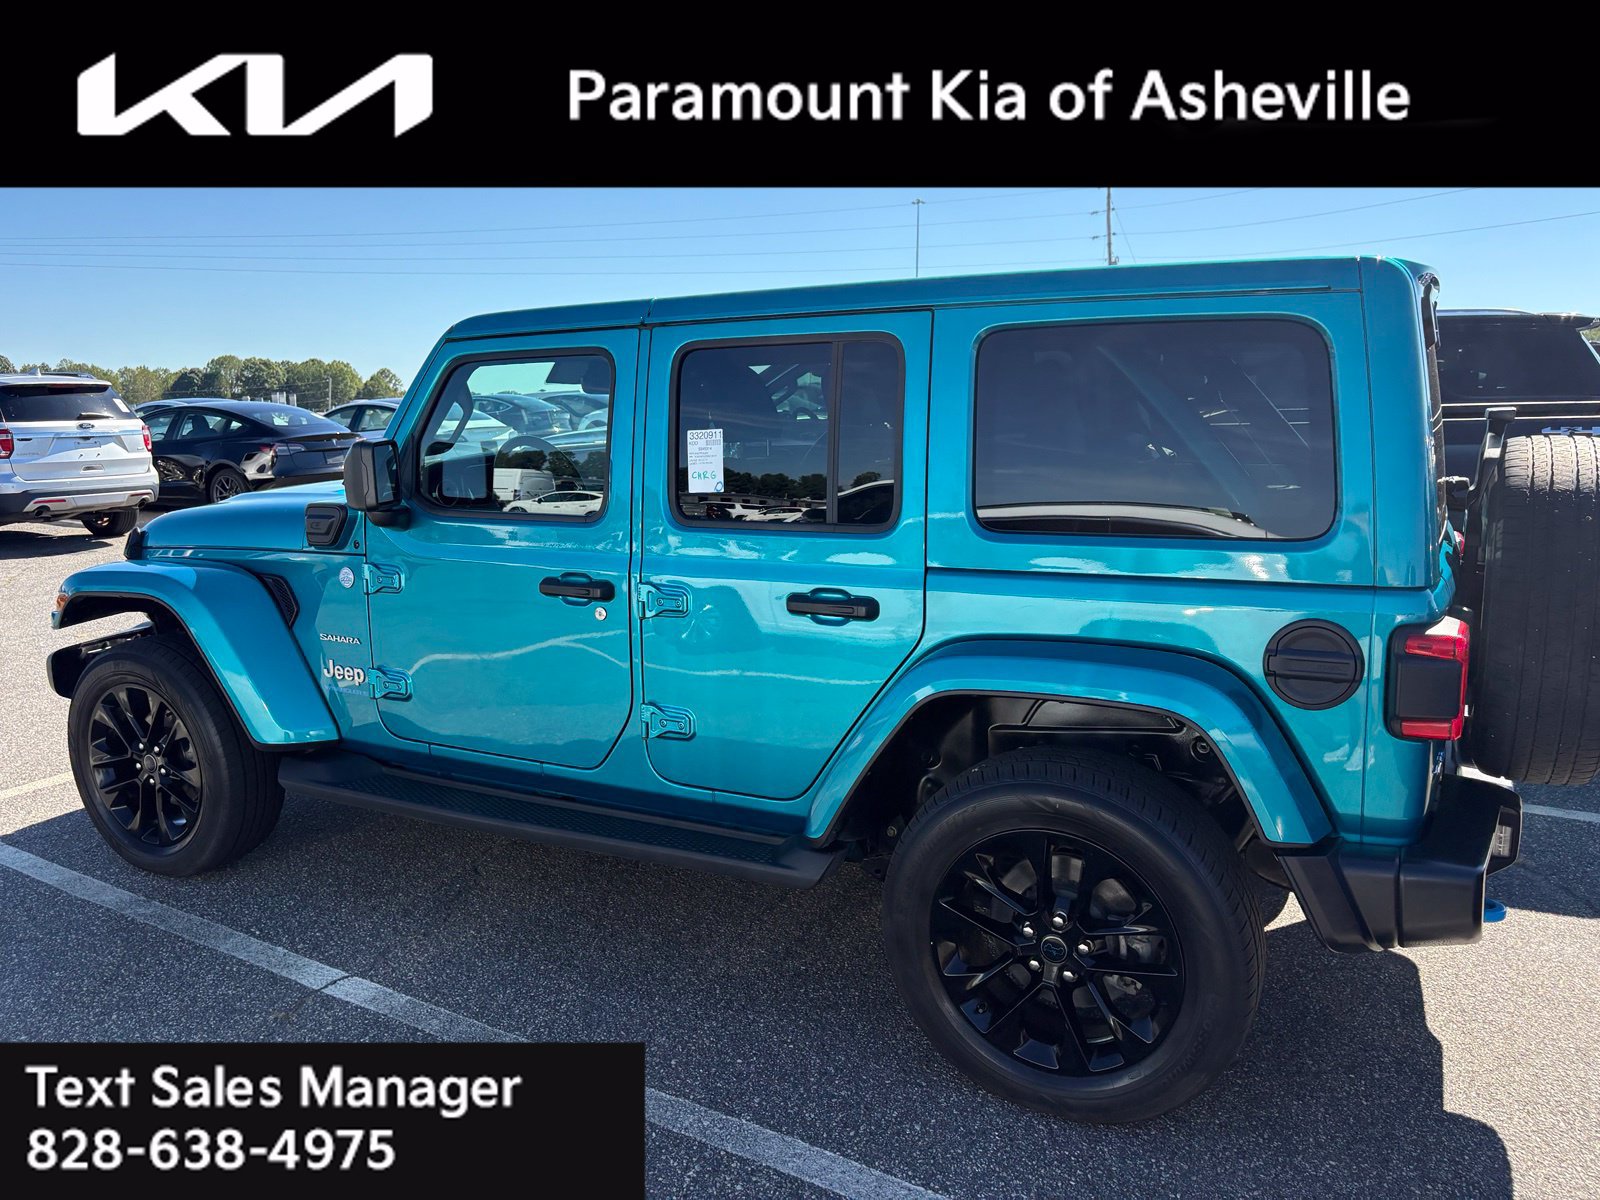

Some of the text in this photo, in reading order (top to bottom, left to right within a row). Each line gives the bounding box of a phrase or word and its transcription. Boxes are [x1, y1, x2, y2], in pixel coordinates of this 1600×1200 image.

[689, 431, 722, 440] 3320911
[319, 633, 361, 645] SAHARA
[323, 659, 365, 686] Jeep
